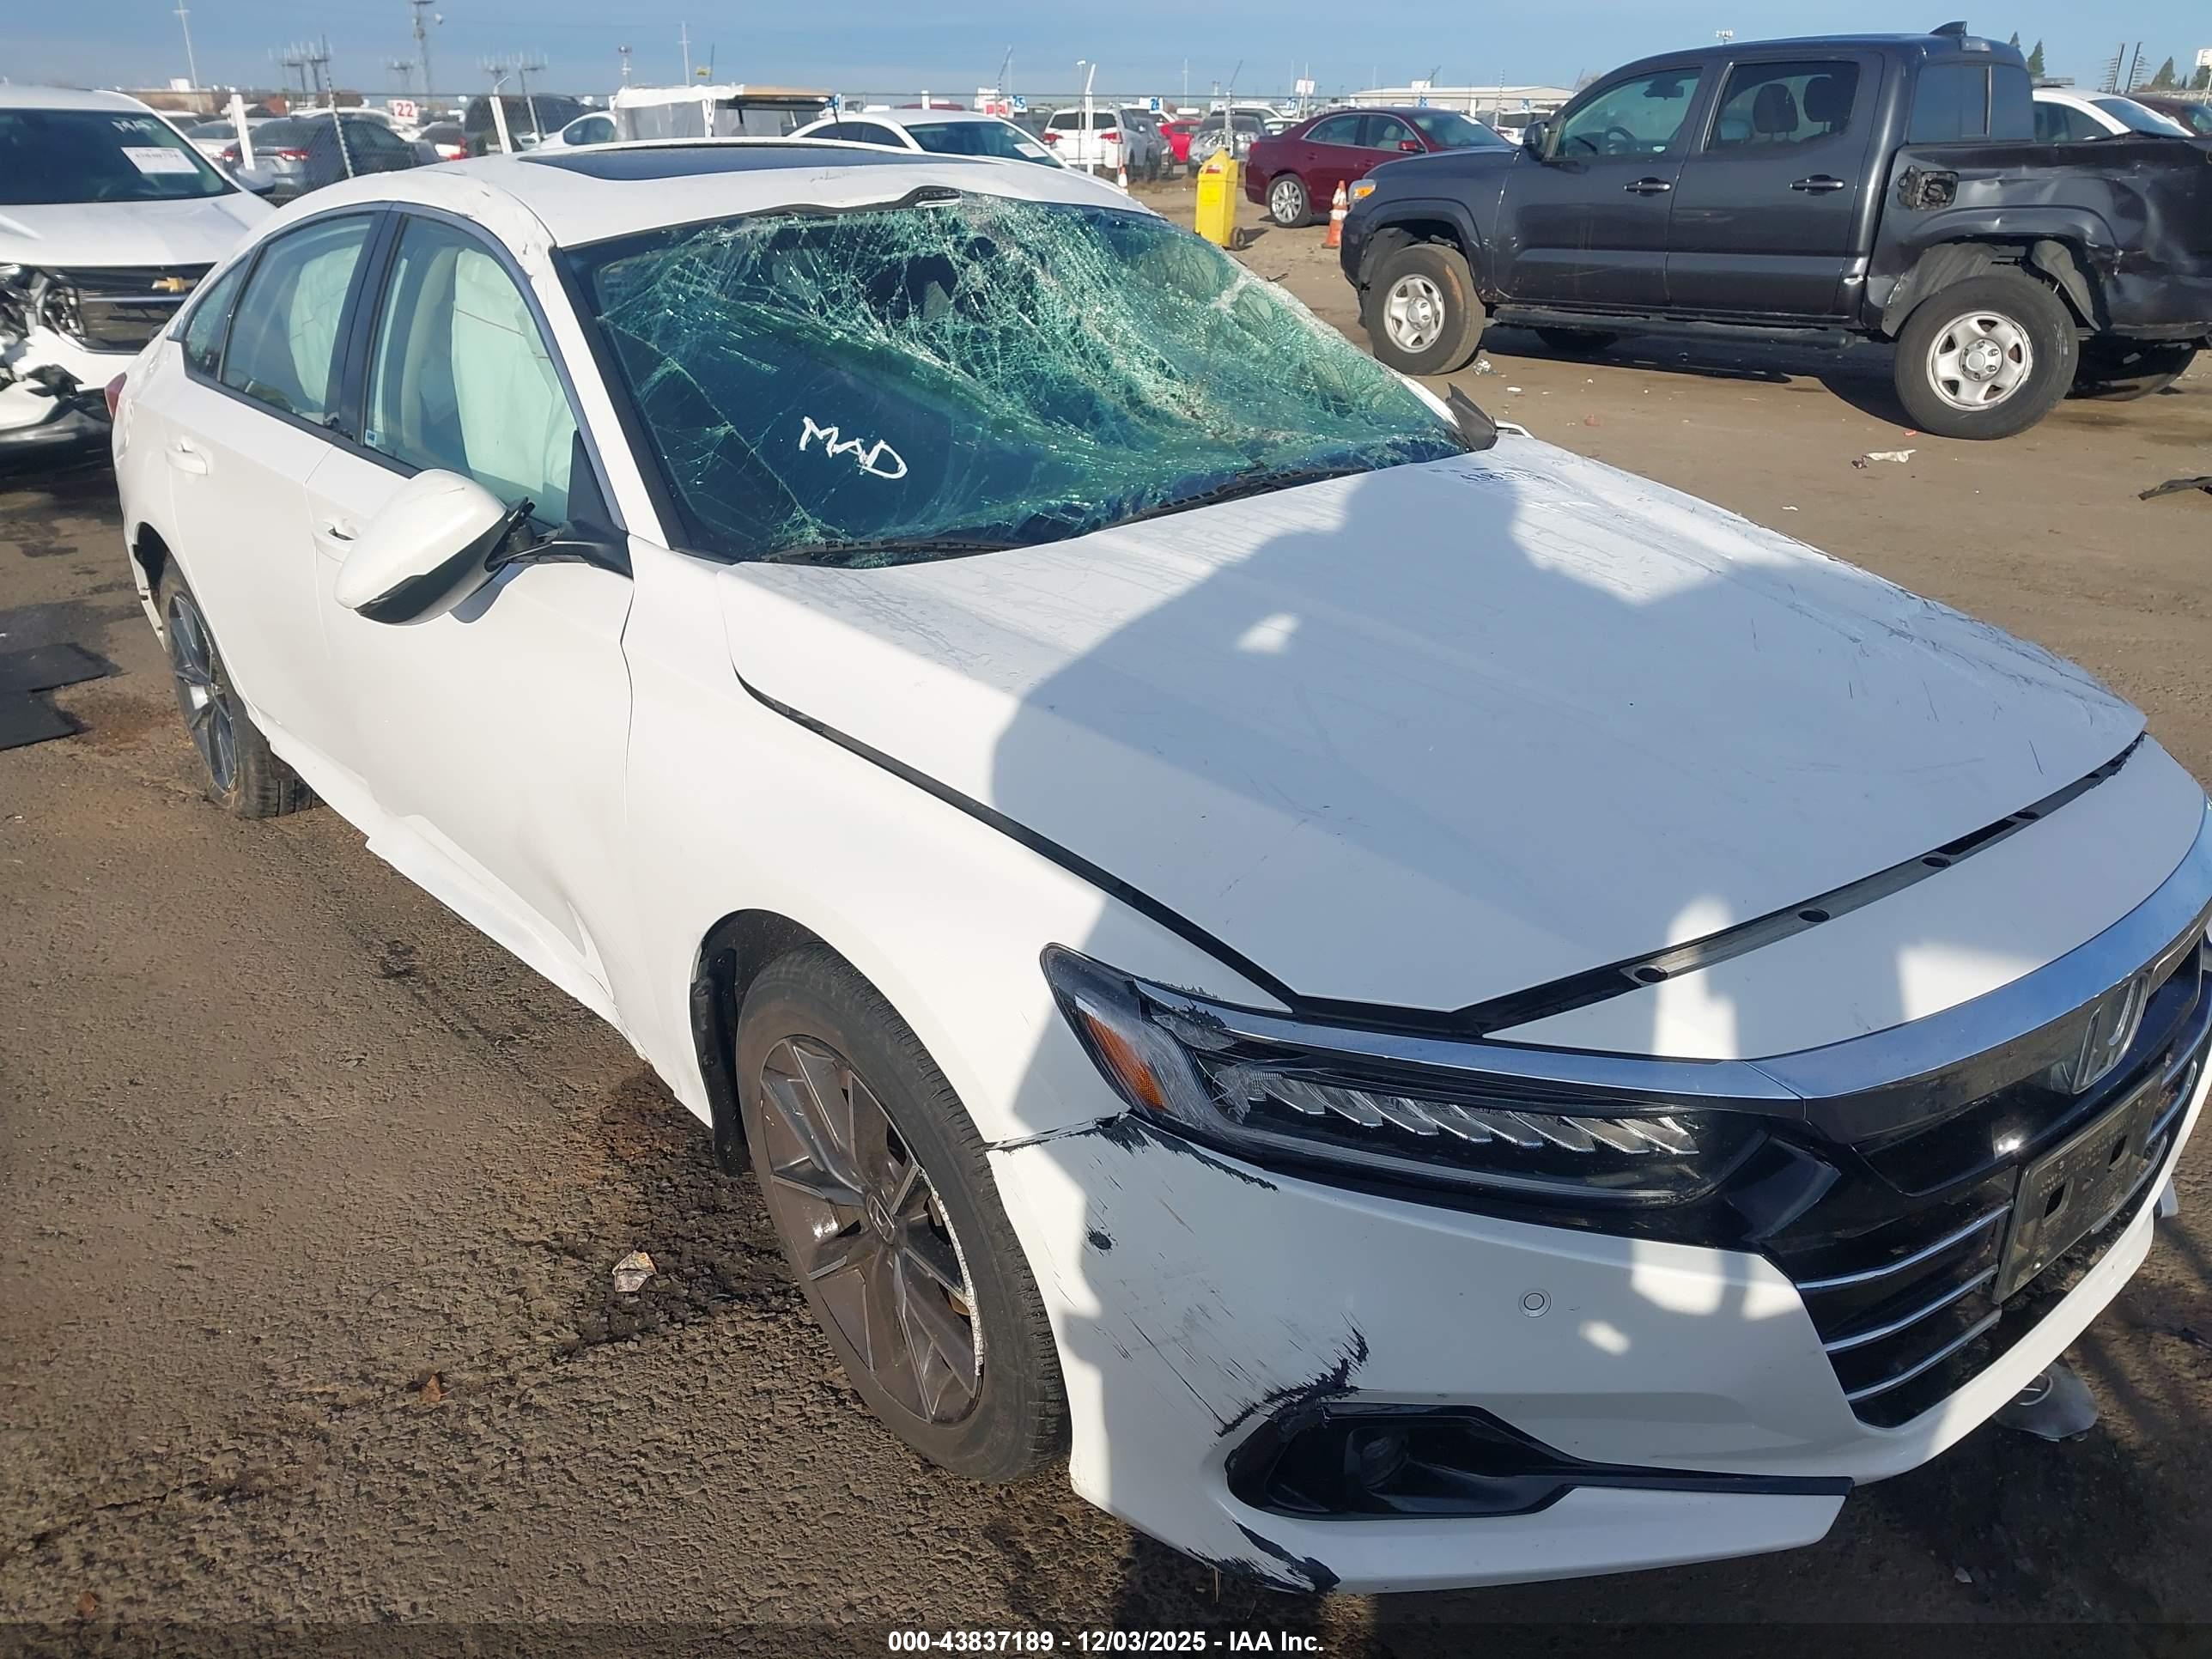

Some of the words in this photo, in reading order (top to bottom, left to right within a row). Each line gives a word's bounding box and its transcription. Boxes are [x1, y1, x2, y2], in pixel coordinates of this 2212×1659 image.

[1012, 95, 1025, 109] 25
[1151, 98, 1160, 111] 26
[397, 102, 414, 118] 22
[798, 415, 908, 480] MAD
